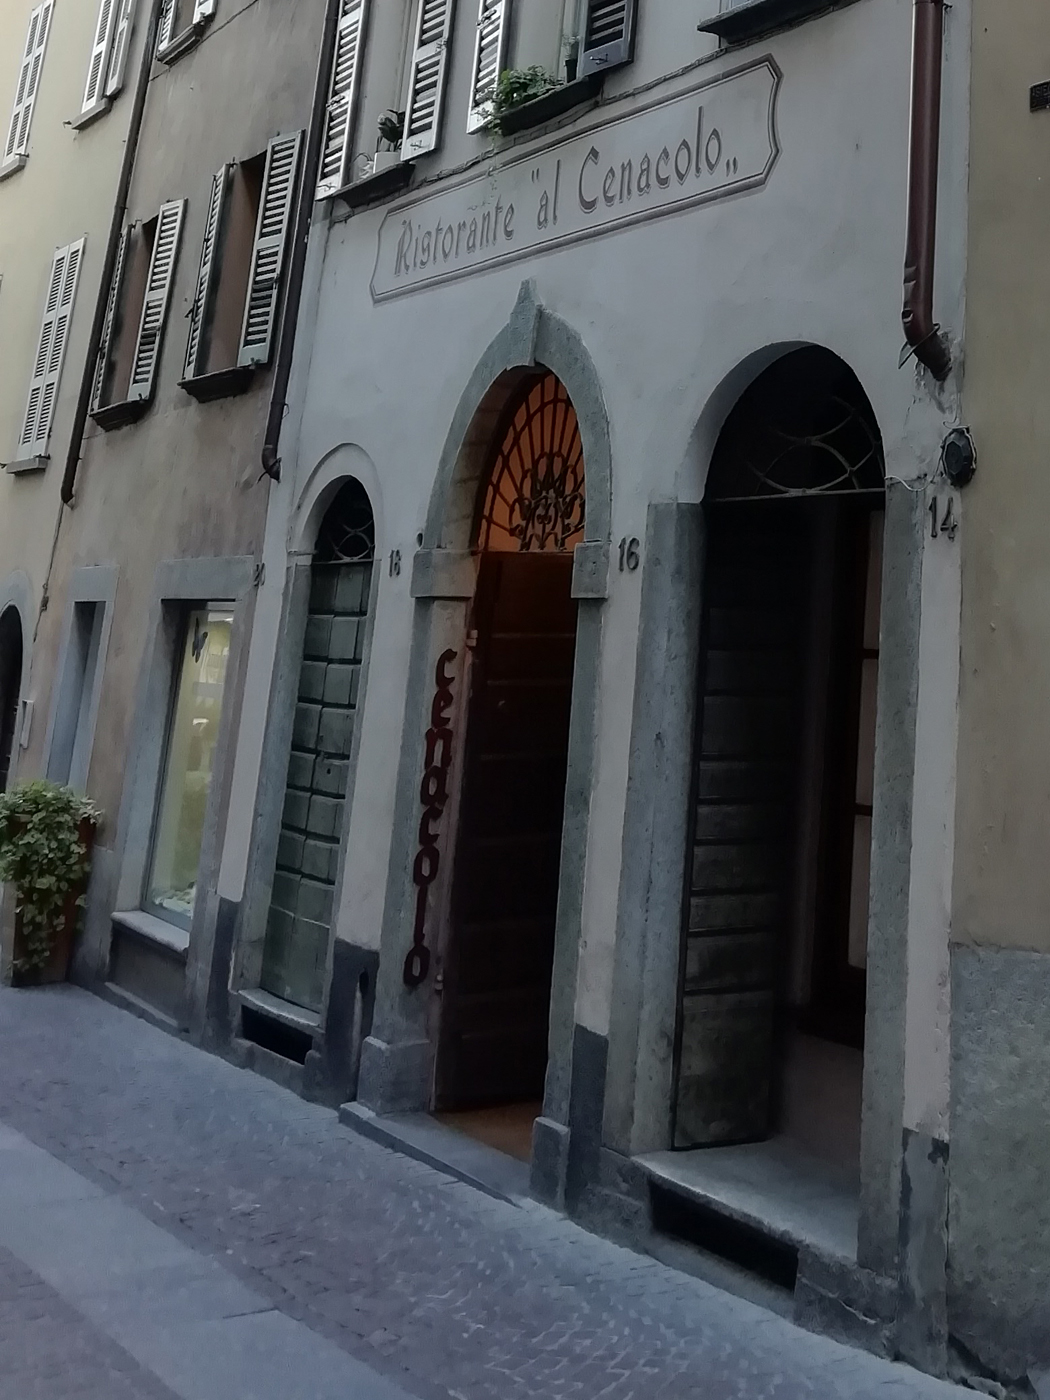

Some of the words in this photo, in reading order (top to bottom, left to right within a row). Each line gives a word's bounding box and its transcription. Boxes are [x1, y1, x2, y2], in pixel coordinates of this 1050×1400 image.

[394, 195, 515, 277] Ristorante
[928, 496, 958, 541] 14
[618, 537, 640, 572] 16
[403, 648, 458, 988] cenacolo
